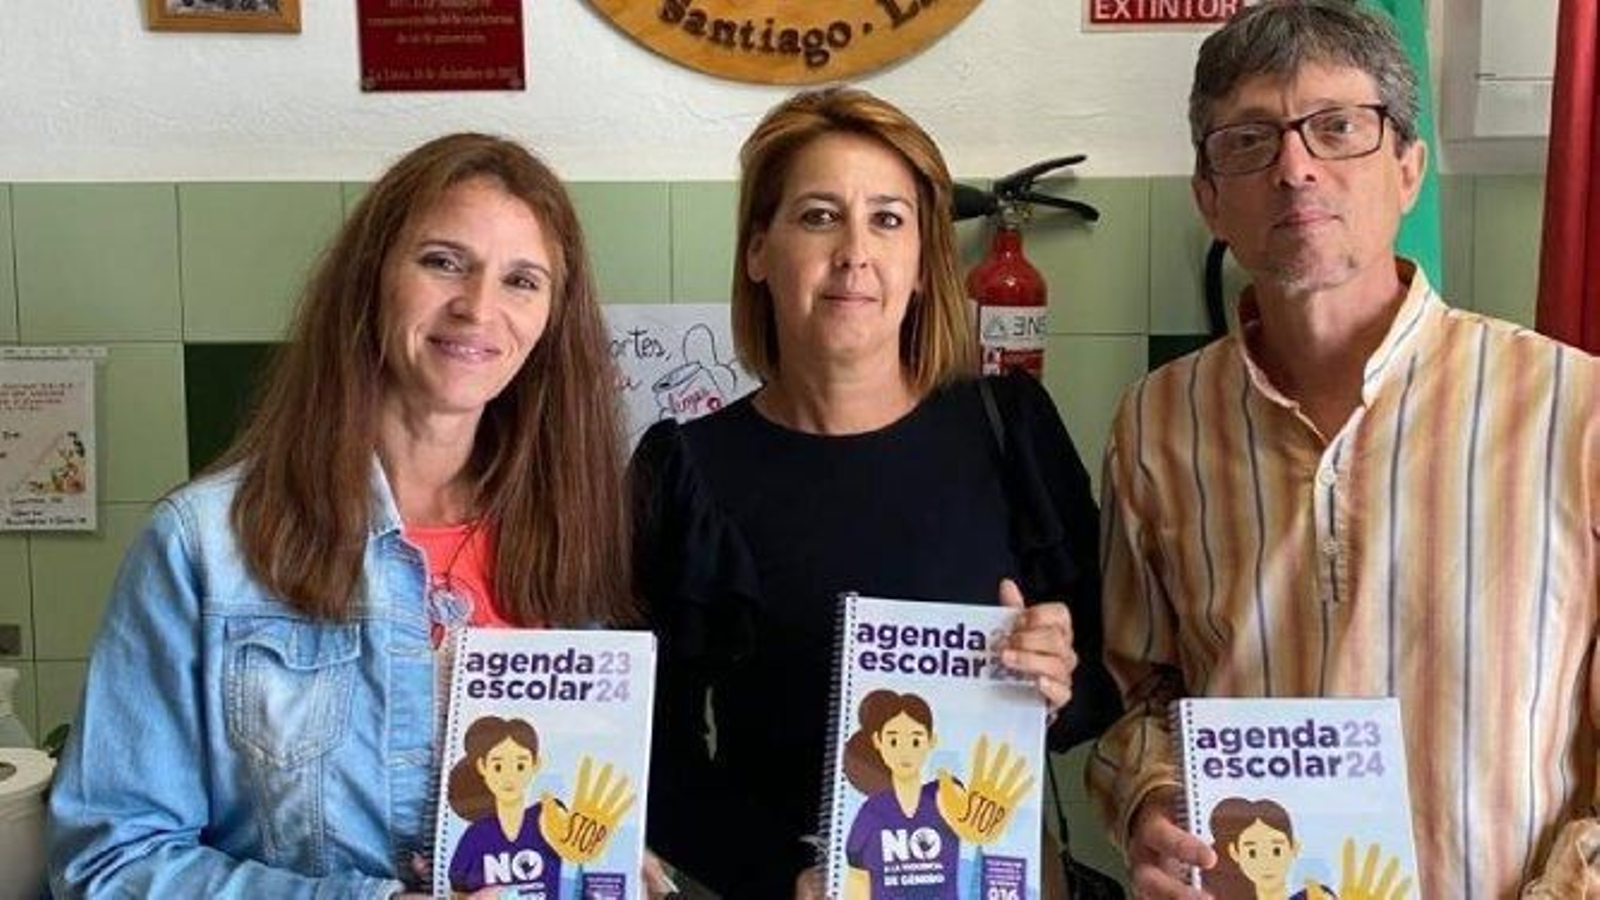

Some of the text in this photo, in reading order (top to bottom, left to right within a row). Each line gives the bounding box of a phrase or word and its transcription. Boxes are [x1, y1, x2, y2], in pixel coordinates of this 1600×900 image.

[1094, 0, 1237, 20] EXTINTOR
[857, 622, 986, 650] agenda
[466, 647, 631, 677] agenda 23
[858, 650, 986, 678] escolar
[467, 674, 631, 702] escolar 24
[1196, 719, 1382, 754] agenda 23
[1203, 749, 1385, 779] escolar 24
[958, 790, 1006, 836] STOP
[560, 812, 608, 854] STOP
[881, 826, 942, 862] NO
[482, 848, 545, 885] NO
[883, 874, 899, 887] DE
